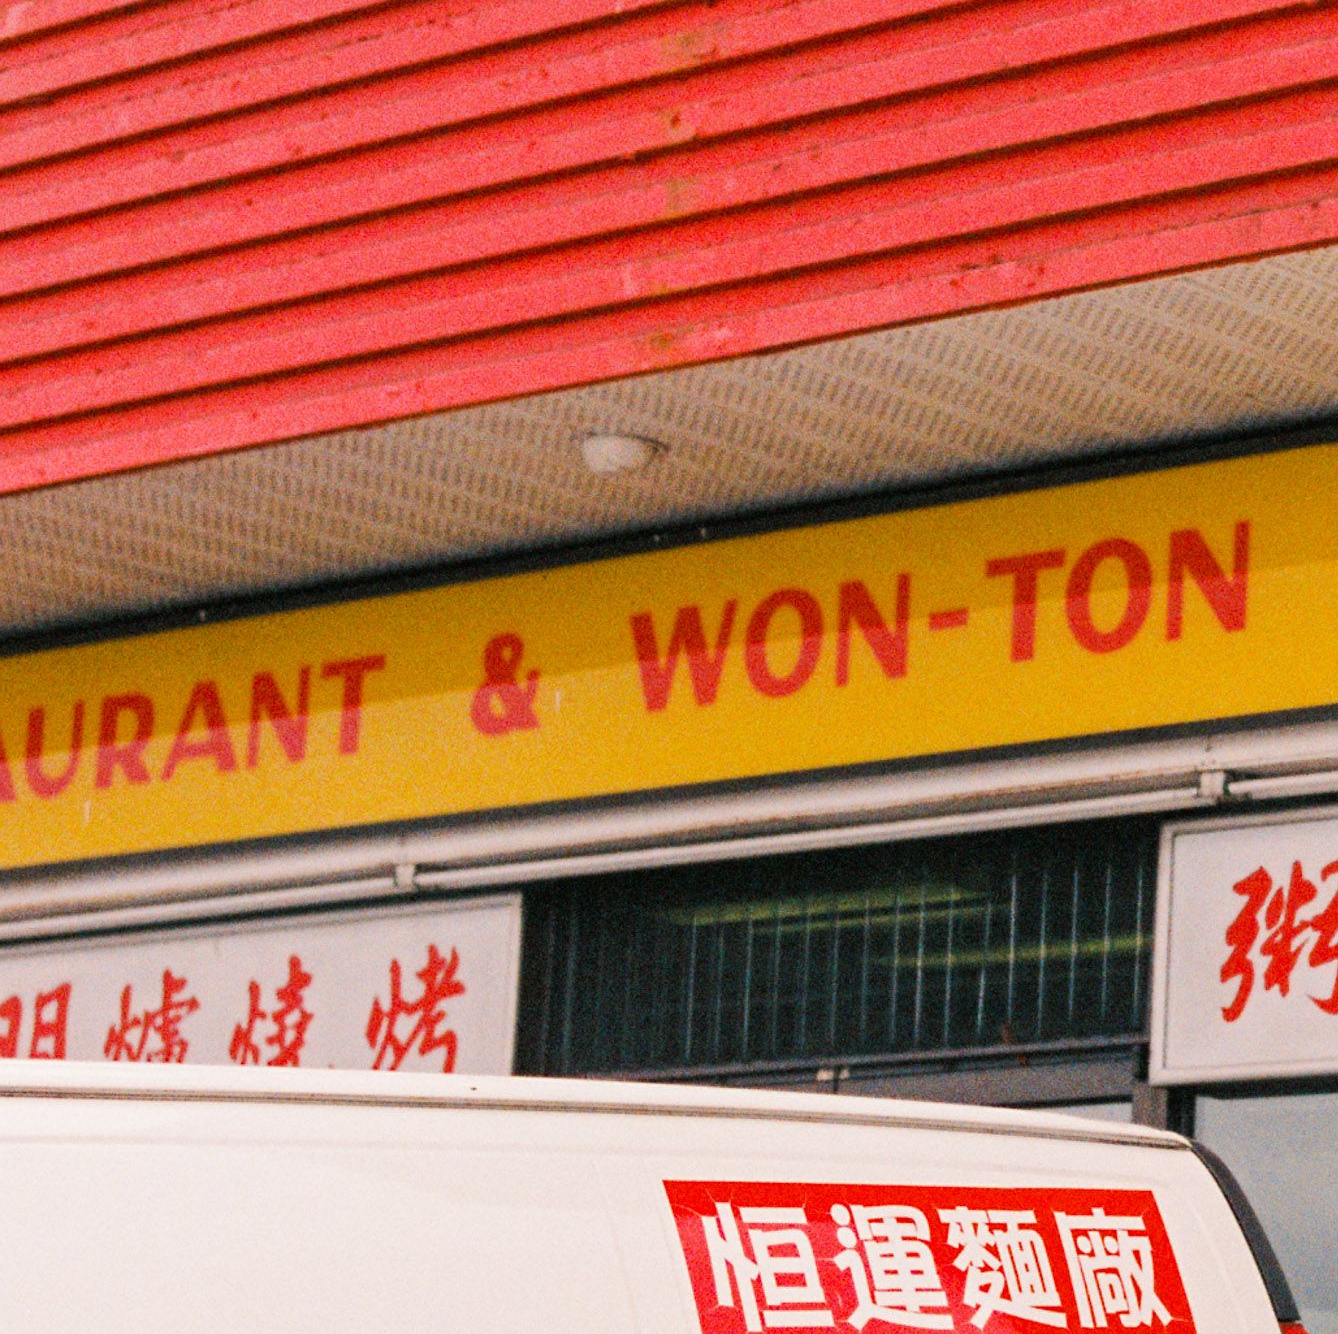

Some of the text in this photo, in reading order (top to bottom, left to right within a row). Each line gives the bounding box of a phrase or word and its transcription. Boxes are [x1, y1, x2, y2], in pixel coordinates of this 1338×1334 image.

[0, 653, 386, 803] URANT
[470, 631, 540, 737] &
[629, 519, 1252, 713] WON-TON
[700, 1201, 1173, 1333] 恒運麵廠
